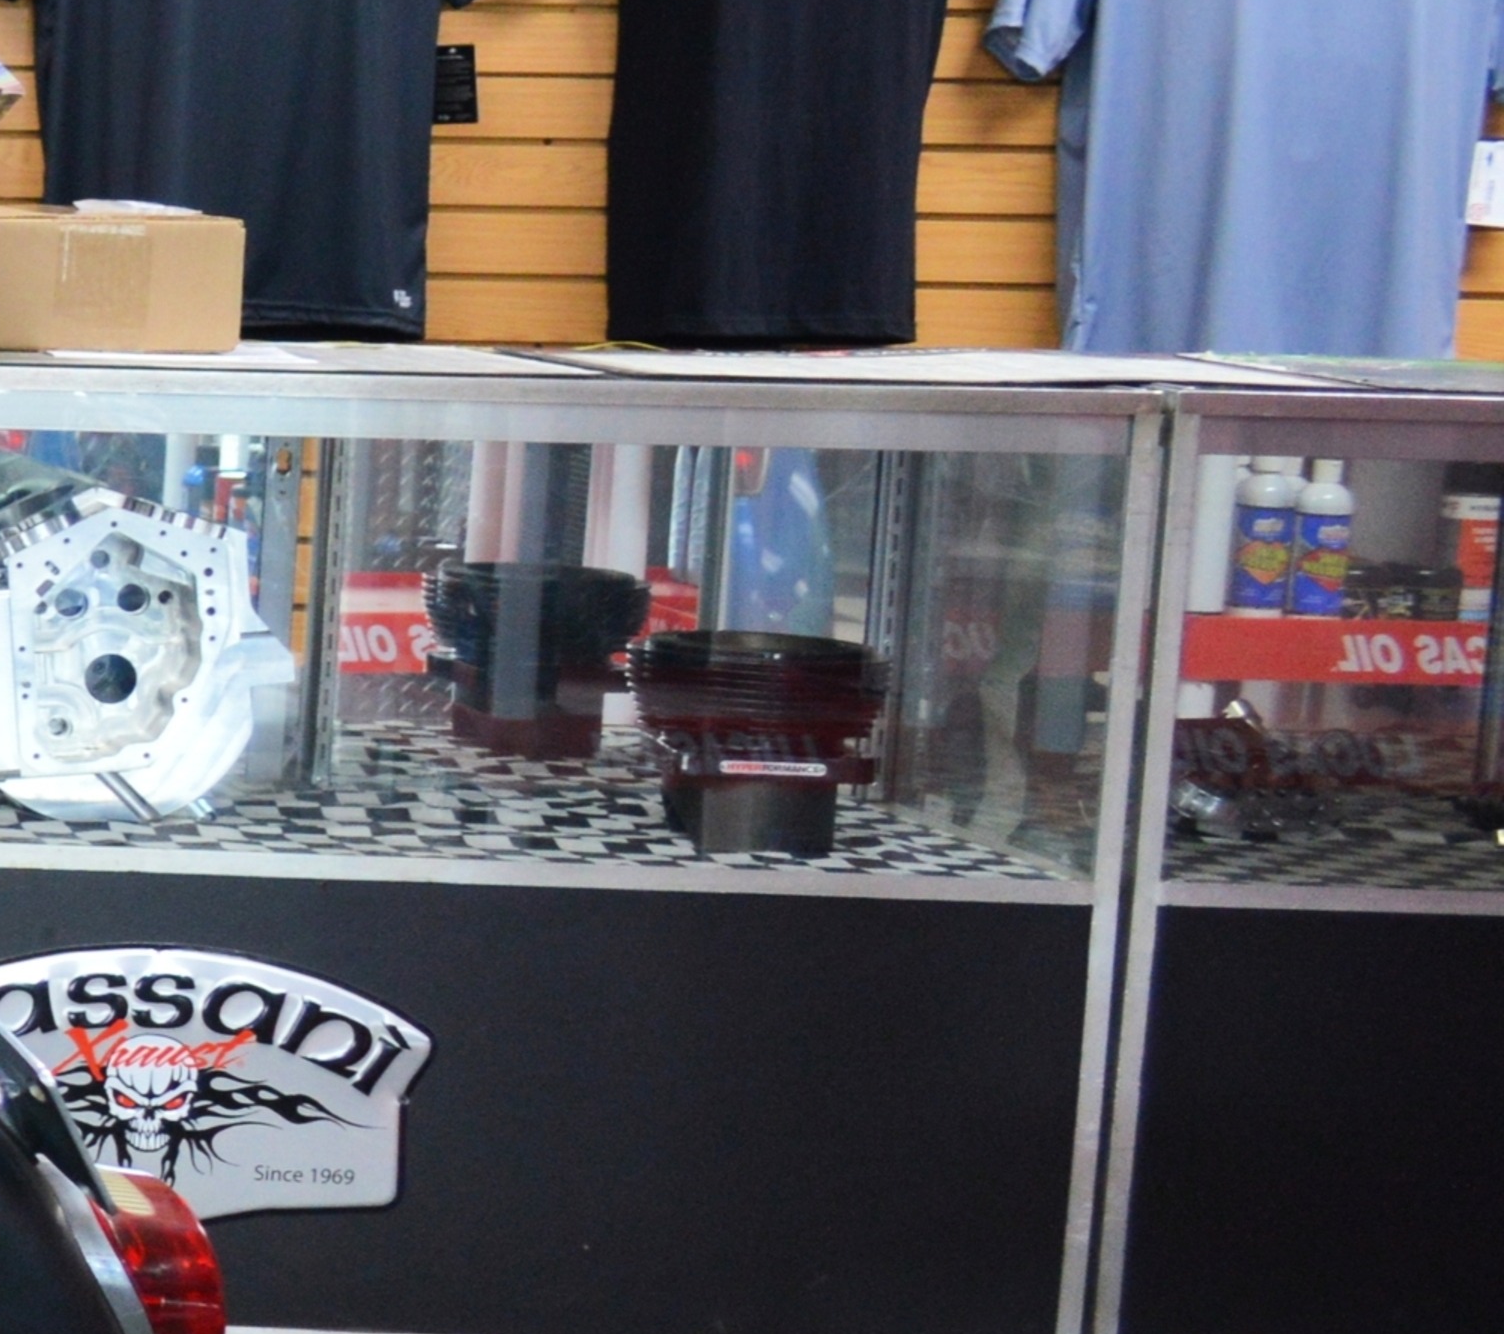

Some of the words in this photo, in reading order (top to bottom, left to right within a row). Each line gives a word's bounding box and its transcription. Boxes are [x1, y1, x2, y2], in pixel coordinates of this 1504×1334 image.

[51, 1019, 256, 1083] Xhaust
[253, 1164, 304, 1184] Since
[308, 1165, 356, 1186] 1969
